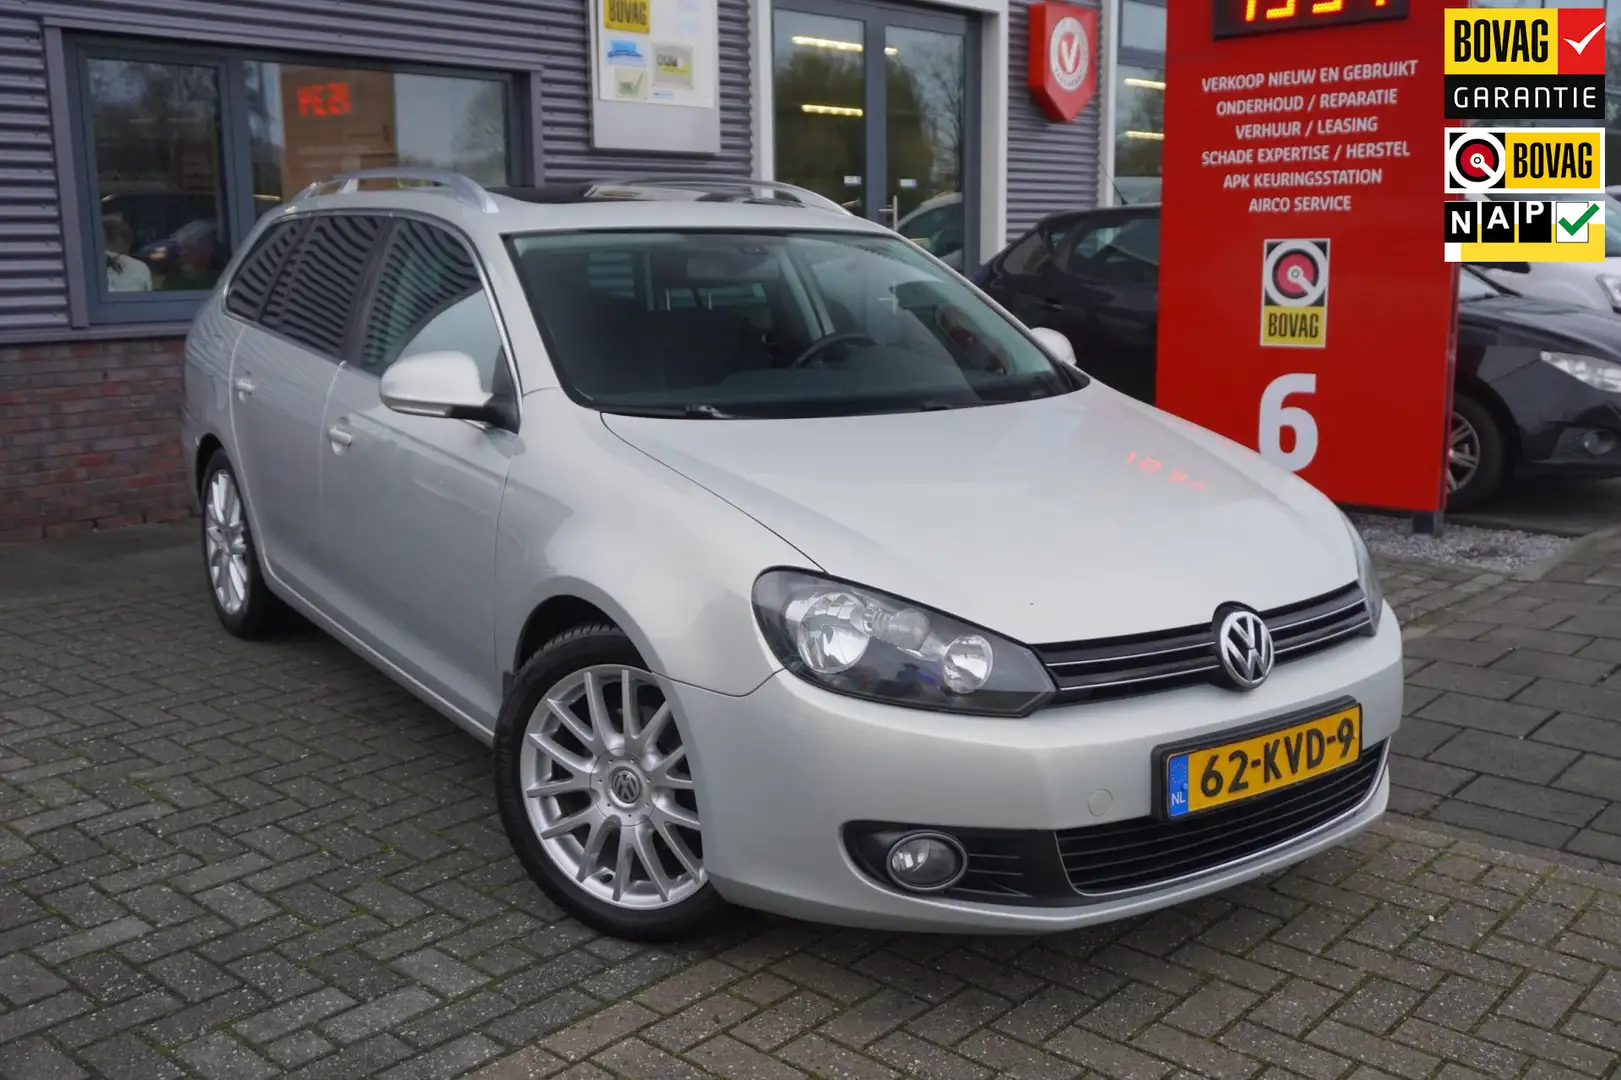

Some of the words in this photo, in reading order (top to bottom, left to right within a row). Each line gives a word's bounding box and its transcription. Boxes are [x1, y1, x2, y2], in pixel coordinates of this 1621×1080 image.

[608, 0, 647, 25] BOVAG
[1201, 72, 1264, 93] VERKOOP
[1268, 68, 1316, 87] NIEUW
[1319, 67, 1340, 83] EN
[1343, 59, 1418, 82] GEBRUIKT
[1216, 95, 1304, 117] ONDERHOUD
[1319, 88, 1398, 109] REPARATIE
[1235, 121, 1301, 140] VERHUUR
[1317, 116, 1378, 135] LEASING
[1201, 149, 1253, 167] SCHADE
[1257, 145, 1329, 164] EXPERTISE
[1345, 141, 1411, 159] HERSTEL
[1223, 174, 1250, 190] APK
[1253, 168, 1382, 188] KEURINGSSTATION
[1248, 197, 1290, 213] AIRCO
[1294, 195, 1352, 212] SERVICE
[1268, 312, 1320, 338] BOVAG
[1258, 372, 1319, 473] 6
[1200, 717, 1354, 799] 62-KVD-9
[1171, 792, 1186, 806] NL
